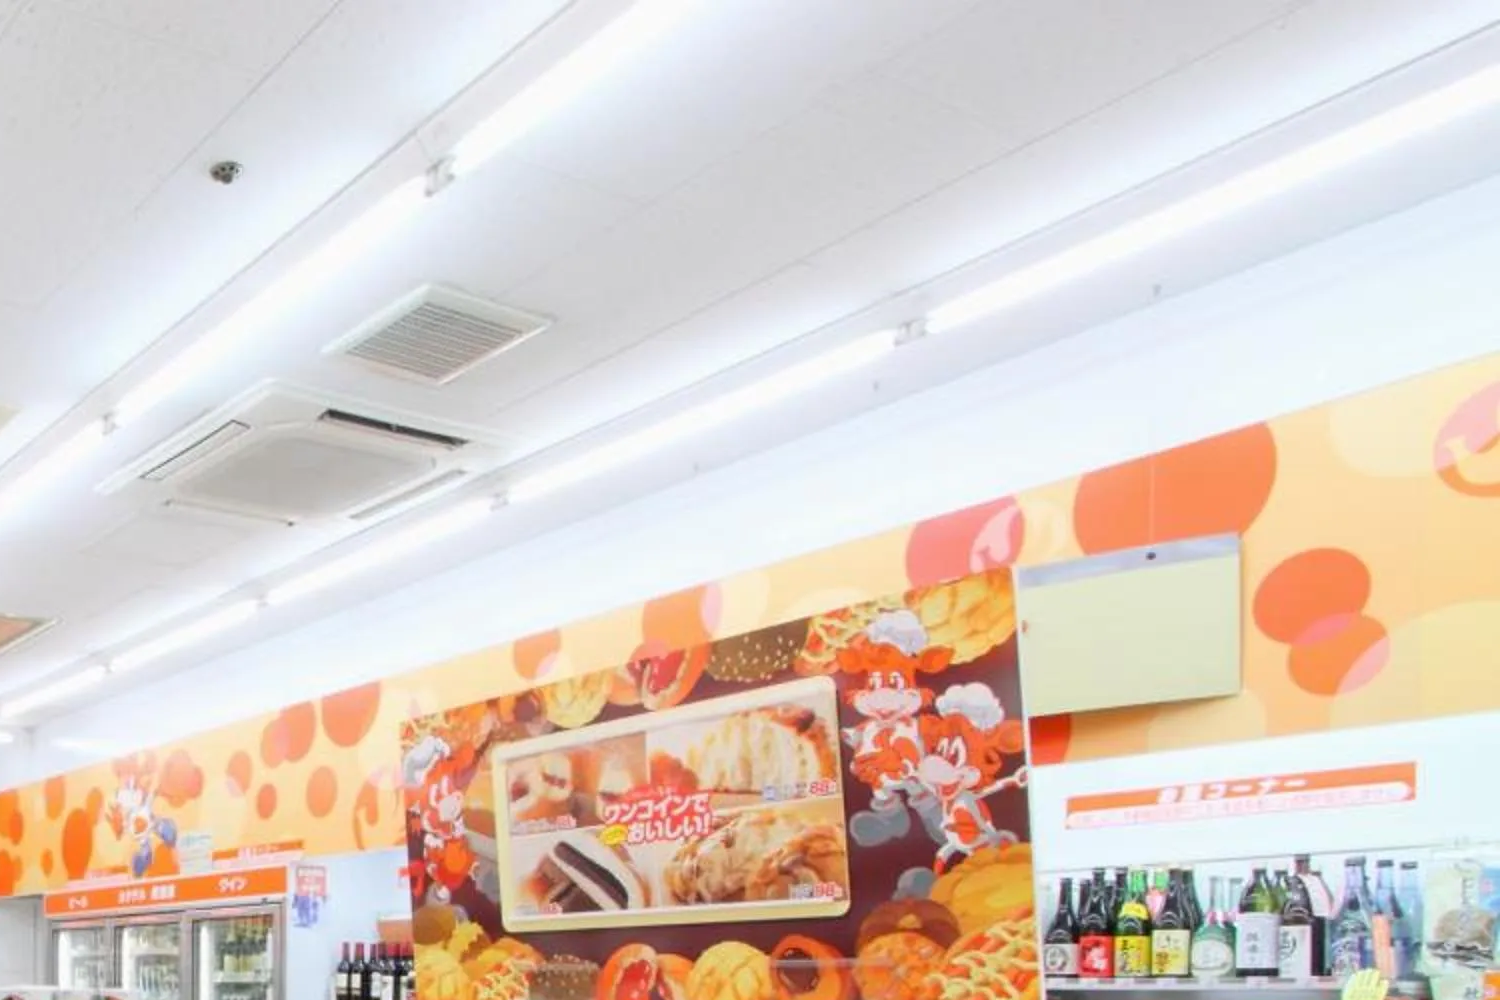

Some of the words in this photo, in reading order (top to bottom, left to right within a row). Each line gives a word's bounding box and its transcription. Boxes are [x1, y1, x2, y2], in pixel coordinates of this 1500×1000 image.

[603, 792, 710, 822] ワンコインで
